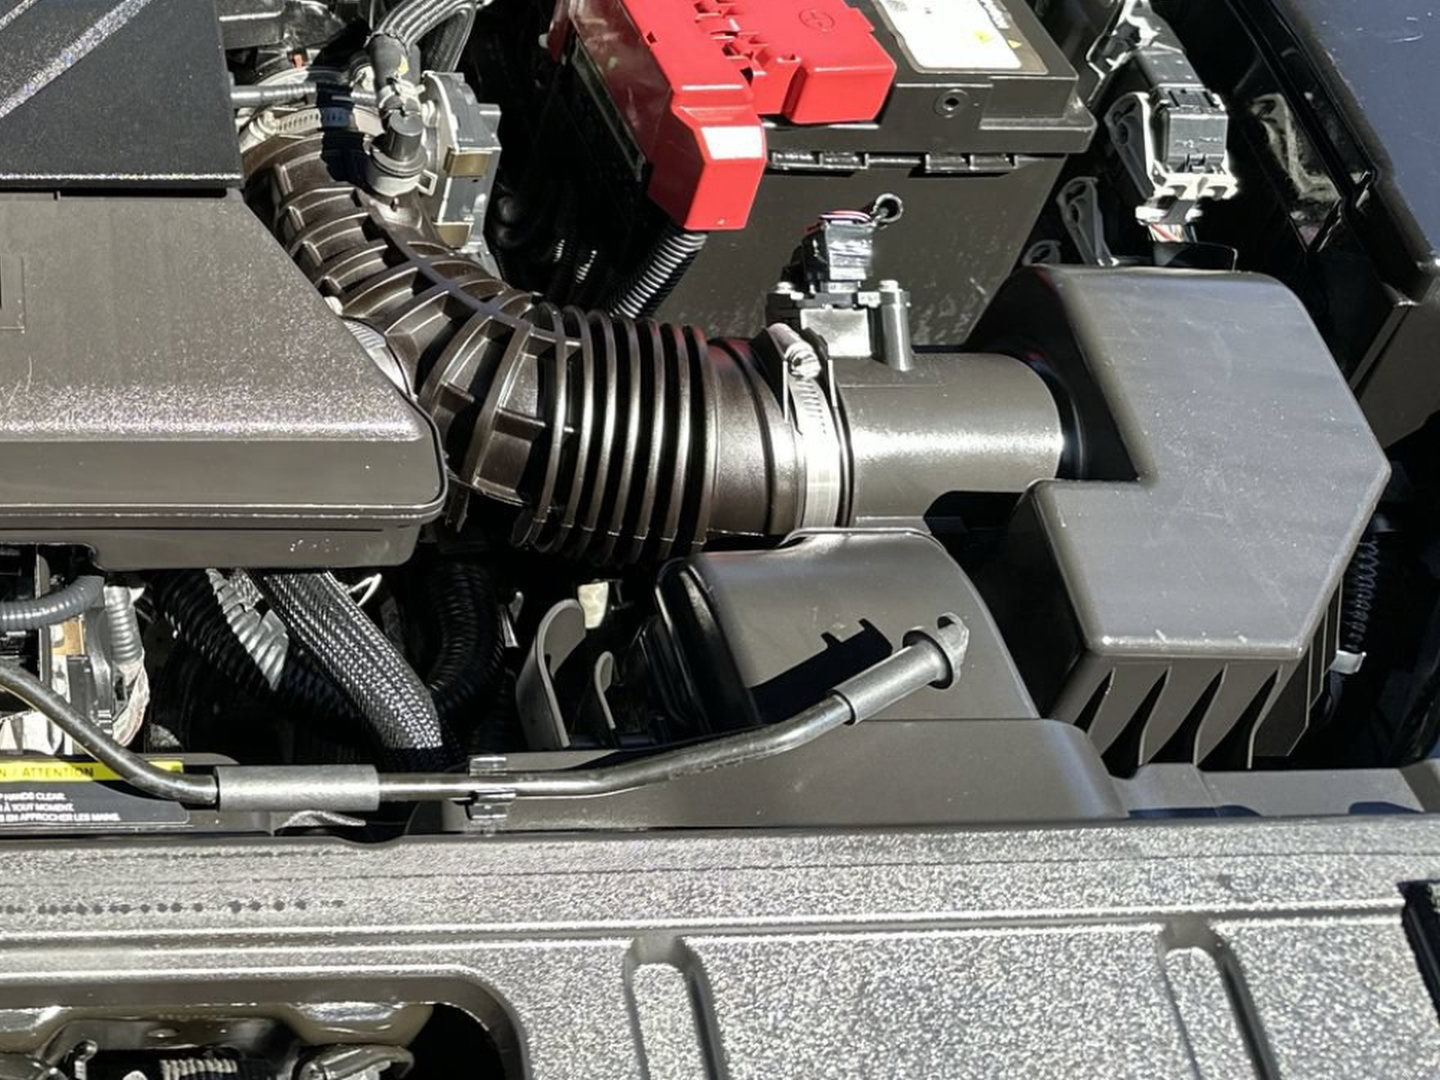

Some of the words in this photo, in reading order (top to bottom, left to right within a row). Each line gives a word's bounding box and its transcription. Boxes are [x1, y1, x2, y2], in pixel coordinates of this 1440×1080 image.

[22, 767, 94, 779] ATTENTION
[4, 792, 34, 801] HANDS
[11, 802, 33, 811] TOUT
[19, 813, 72, 822] APPROCHER
[73, 813, 90, 821] LES
